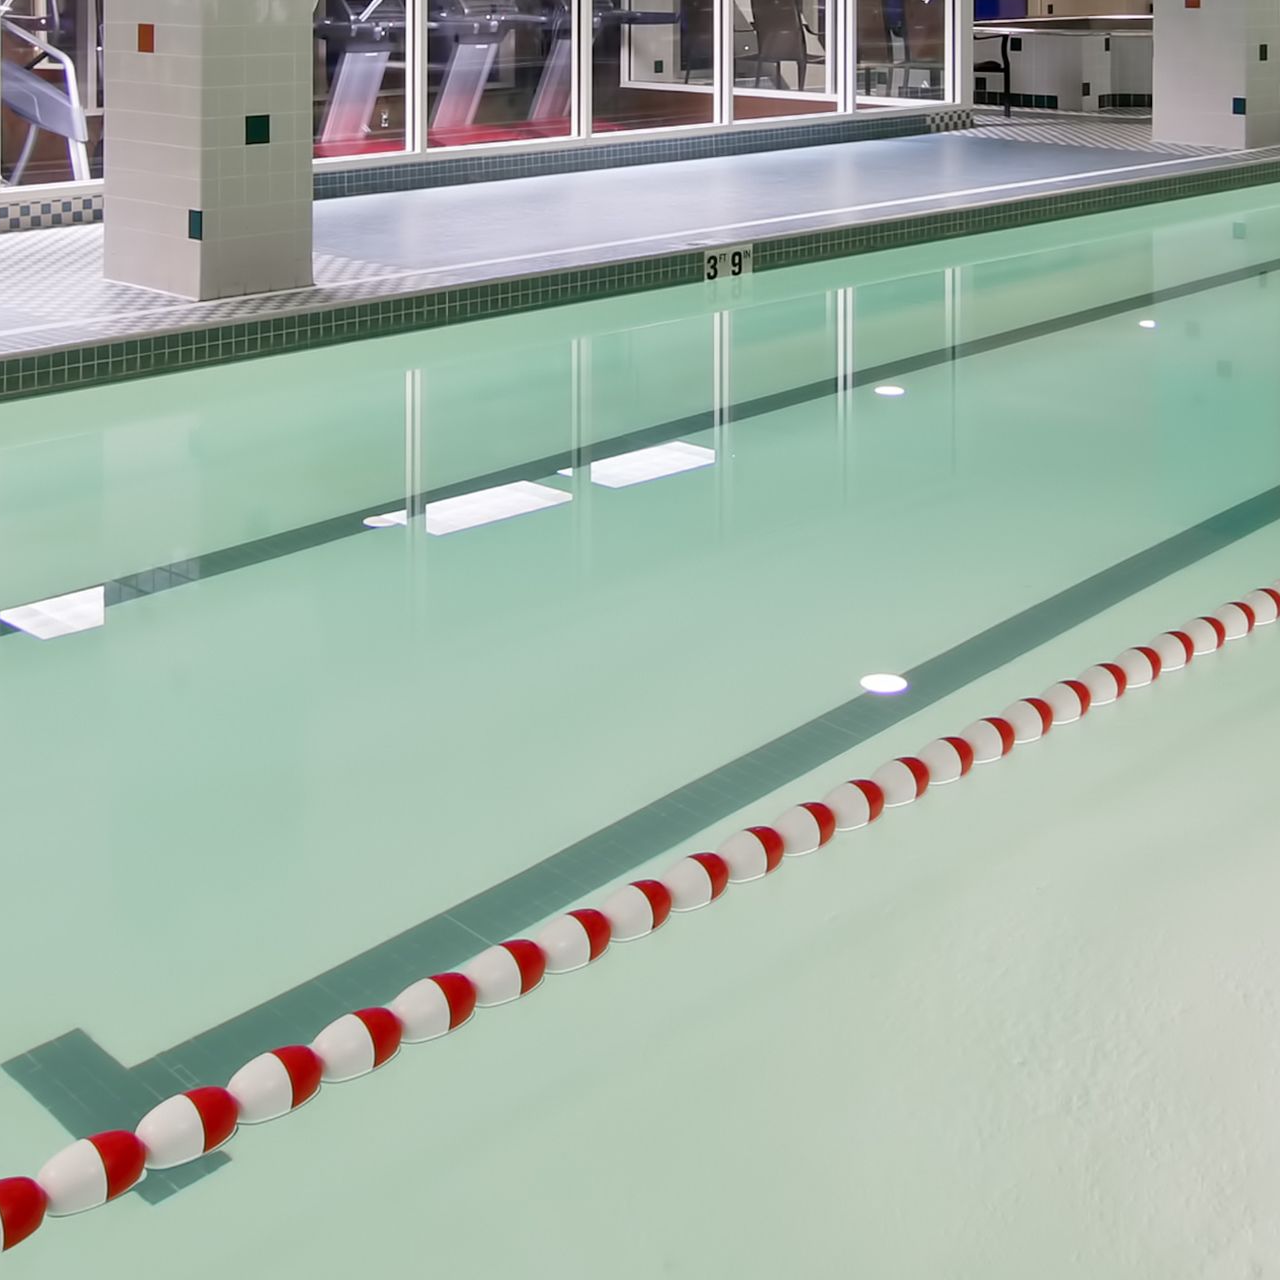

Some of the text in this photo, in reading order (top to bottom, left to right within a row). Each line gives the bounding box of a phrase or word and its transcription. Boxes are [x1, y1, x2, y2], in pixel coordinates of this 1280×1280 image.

[706, 250, 751, 280] 3 FT 9 IN
